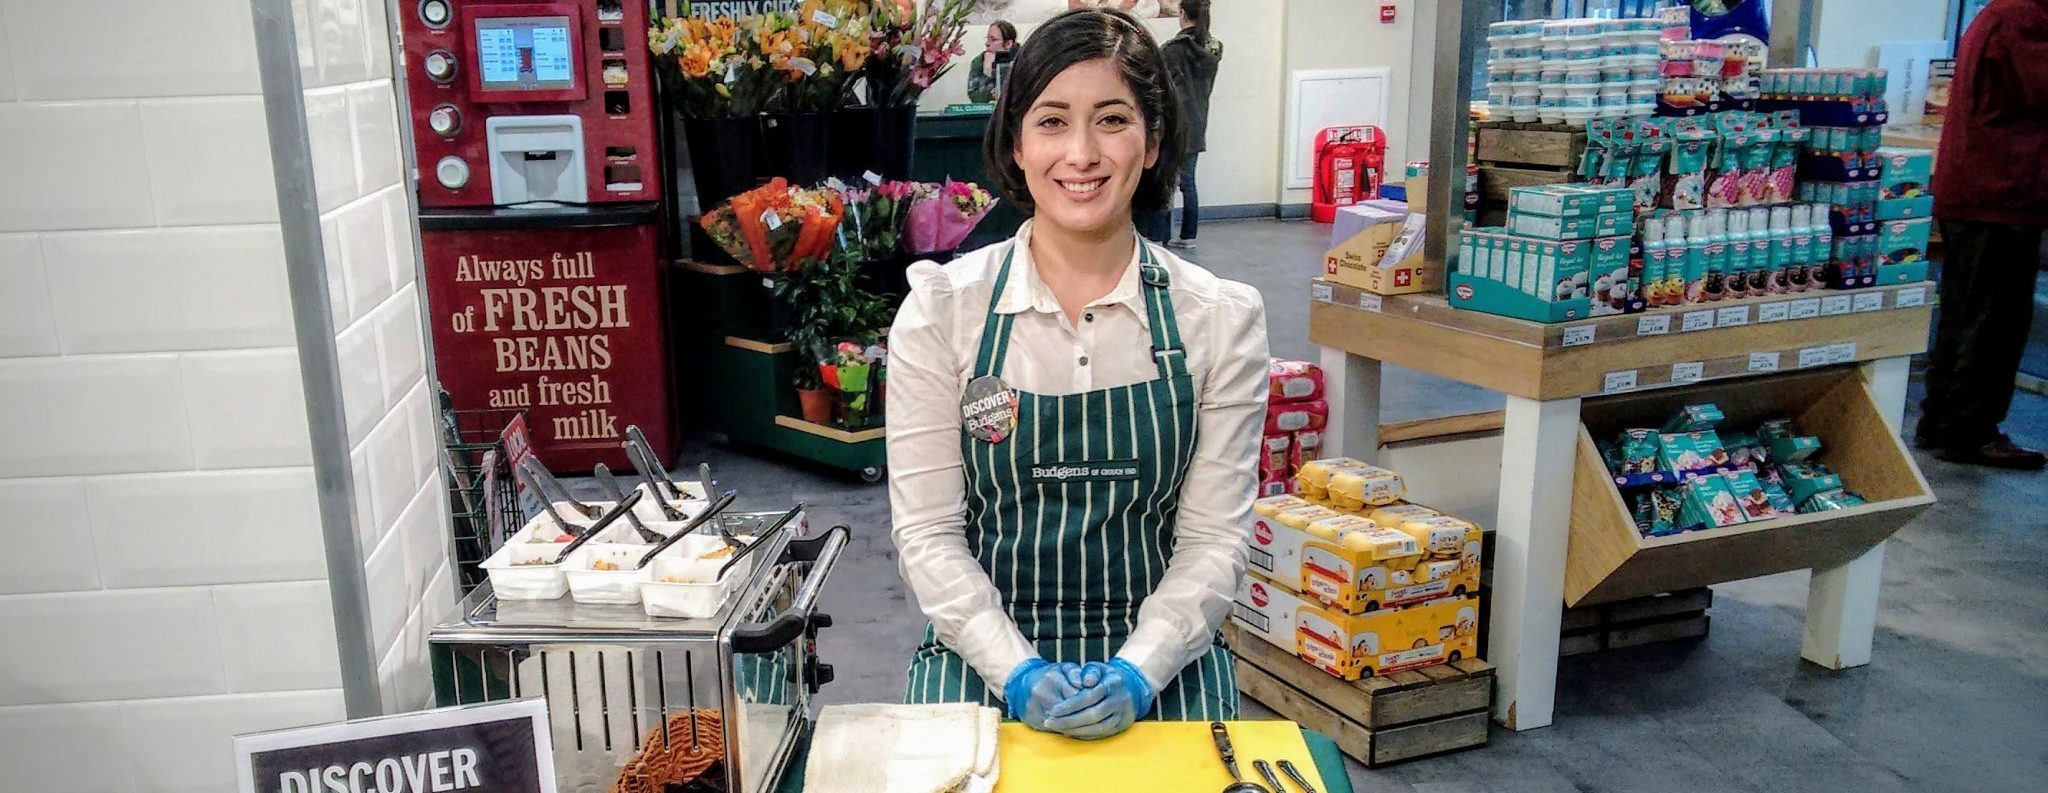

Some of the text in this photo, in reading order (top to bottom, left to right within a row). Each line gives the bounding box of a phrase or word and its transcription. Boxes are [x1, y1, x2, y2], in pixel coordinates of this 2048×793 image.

[691, 1, 758, 23] FRESHLY
[455, 252, 596, 286] Always full
[452, 284, 630, 333] of FRESH
[493, 334, 611, 372] BEANS
[489, 374, 612, 408] and fresh
[962, 390, 1009, 418] DISCOVER
[552, 409, 619, 440] milk
[968, 408, 1012, 430] Budgens
[1032, 466, 1090, 480] Budgens
[279, 748, 481, 793] DISCOVER
